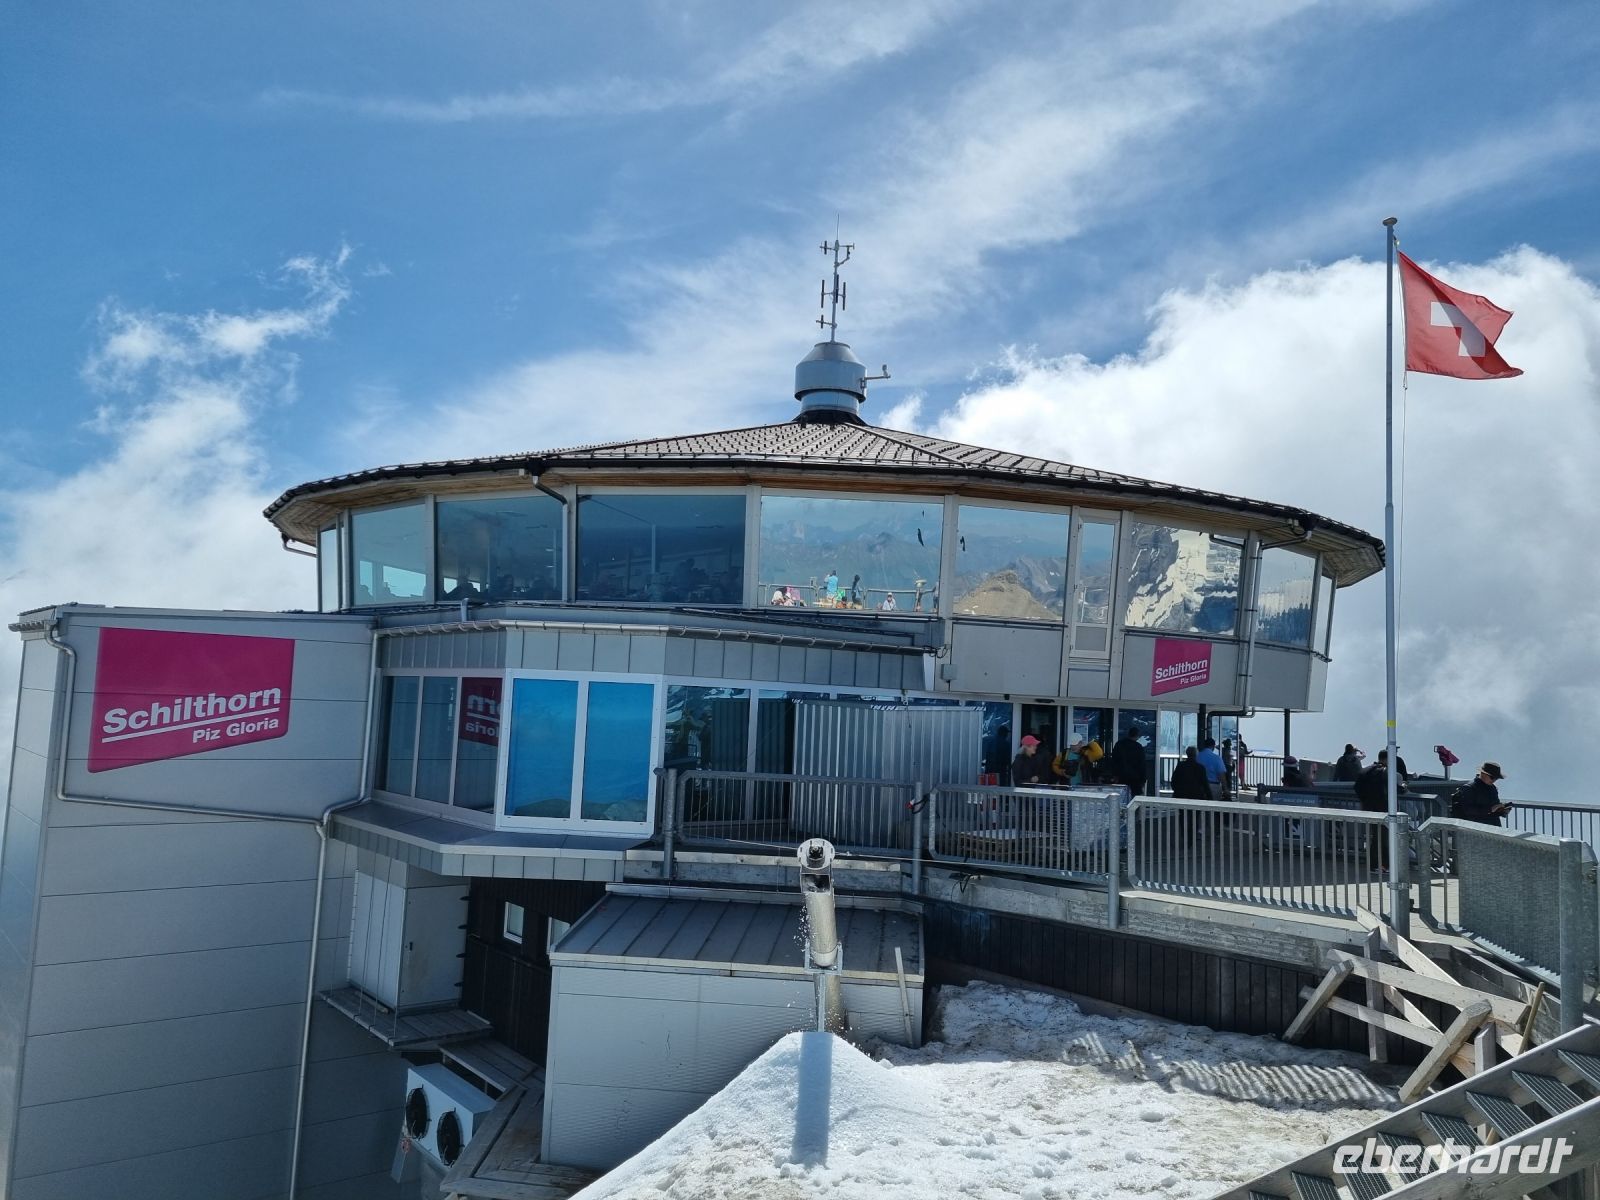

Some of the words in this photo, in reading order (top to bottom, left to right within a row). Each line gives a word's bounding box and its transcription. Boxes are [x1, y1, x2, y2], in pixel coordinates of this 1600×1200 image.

[1155, 659, 1208, 680] Schilthorn
[103, 687, 281, 734] Schilthorn
[192, 728, 221, 743] Piz
[226, 716, 279, 737] Gloria
